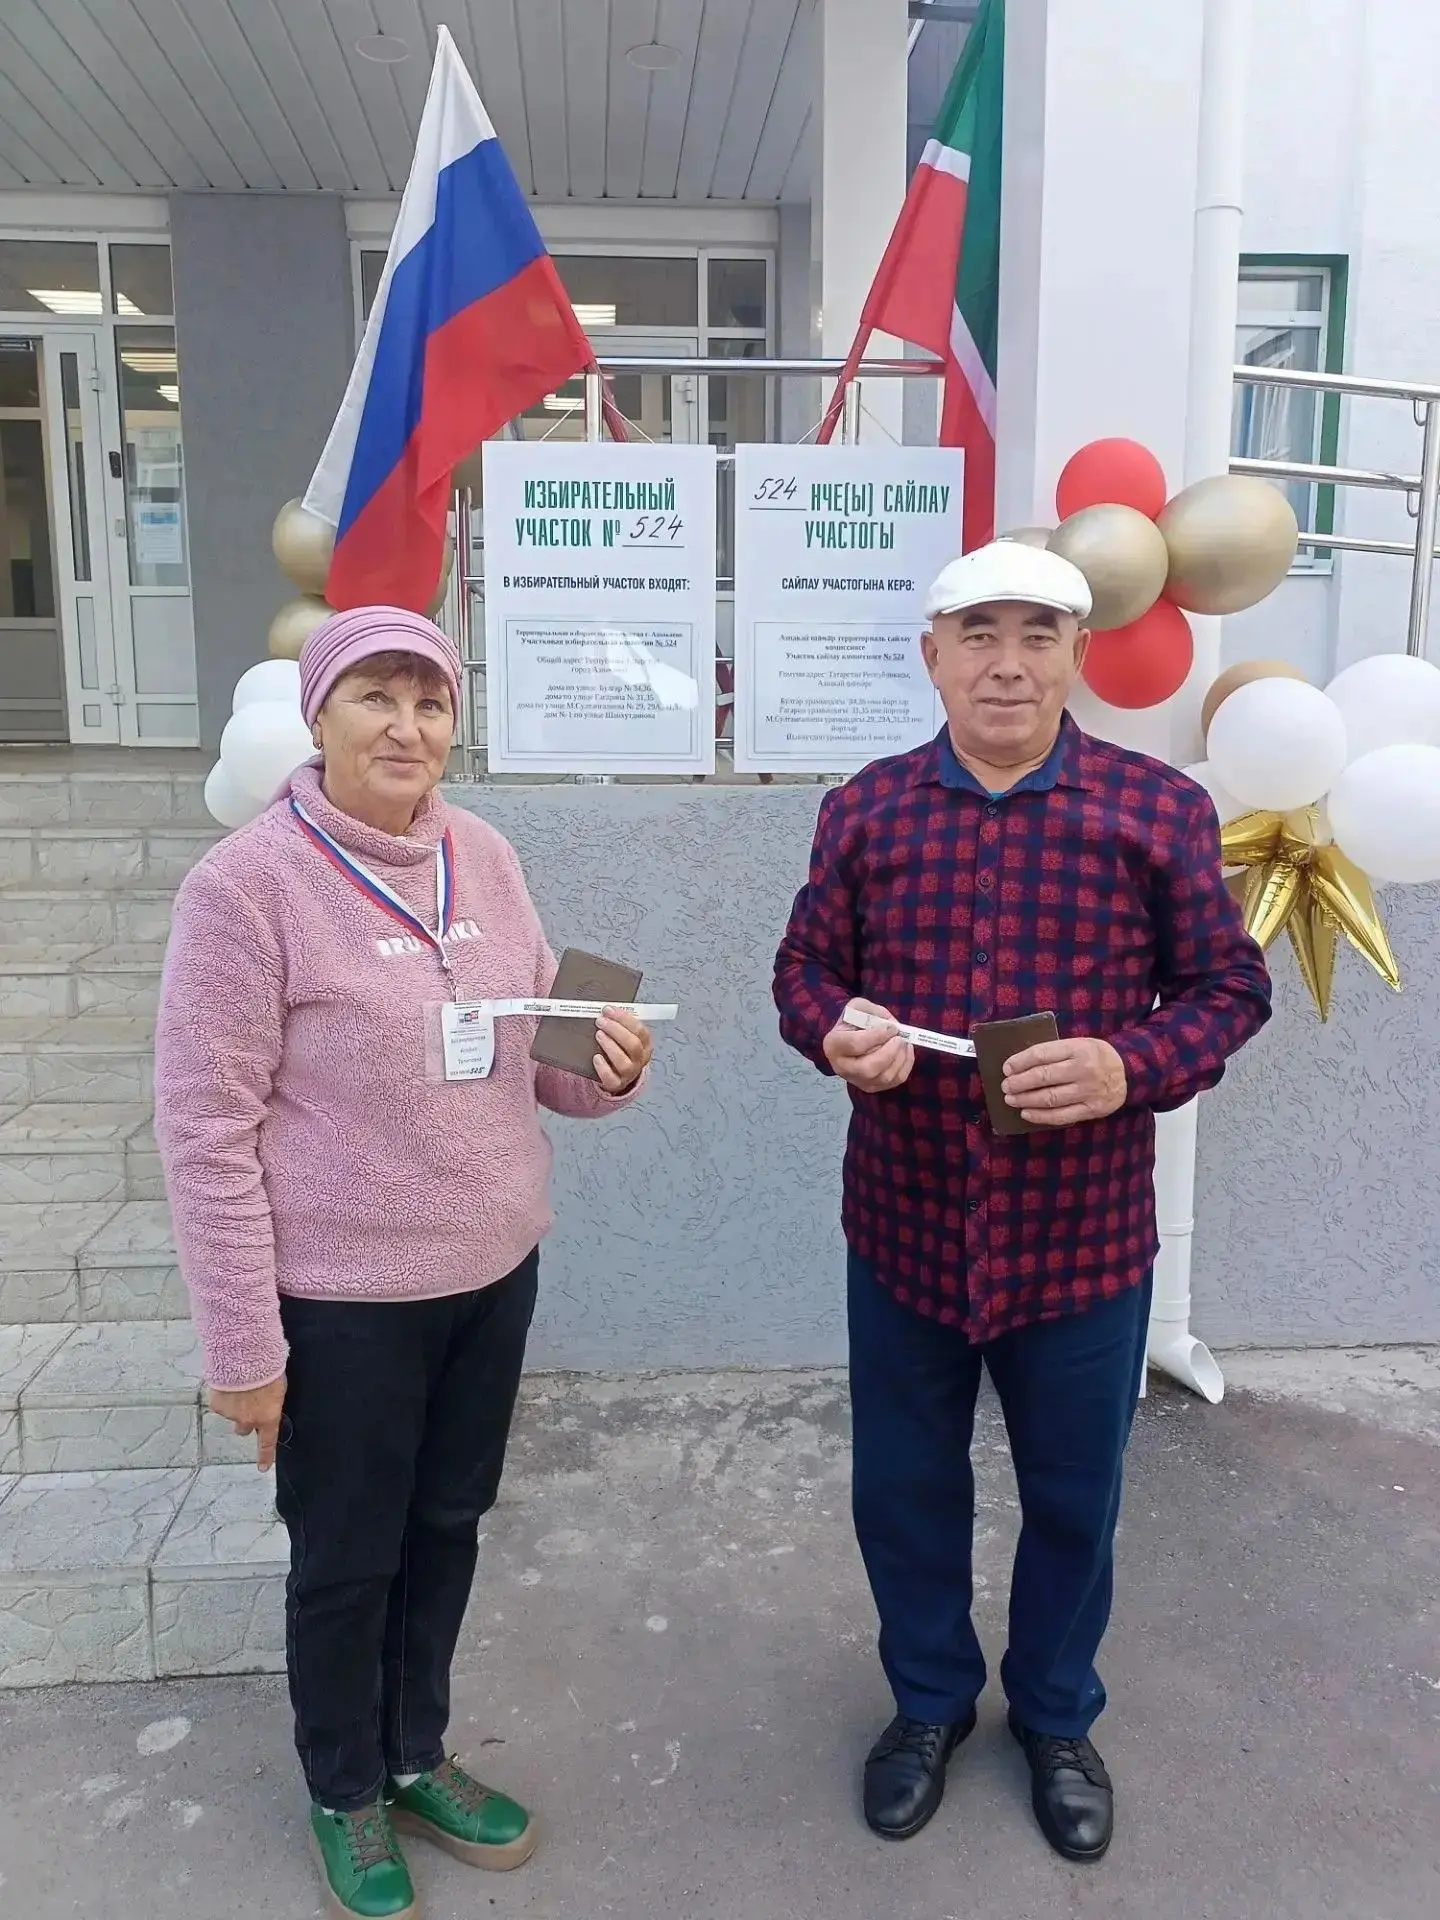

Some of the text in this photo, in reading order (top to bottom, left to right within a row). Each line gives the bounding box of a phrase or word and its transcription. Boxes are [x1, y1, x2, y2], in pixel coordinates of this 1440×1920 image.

[524, 478, 675, 510] ИЗБИРАТЕЛЬНЫЙ
[754, 476, 950, 517] 524 НЧЕ(Ы) САЙЛАУ
[516, 518, 592, 546] УЧАСТОК
[630, 514, 684, 541] 524
[805, 521, 894, 549] УЧАСТОГЫ
[503, 575, 690, 592] В ИЗБИРАТЕЛЬНЫЙ УЧАСТОК ВХОДЯТ:
[782, 576, 820, 590] САЙЛАУ
[822, 578, 885, 591] УЧАСТОГЫНА
